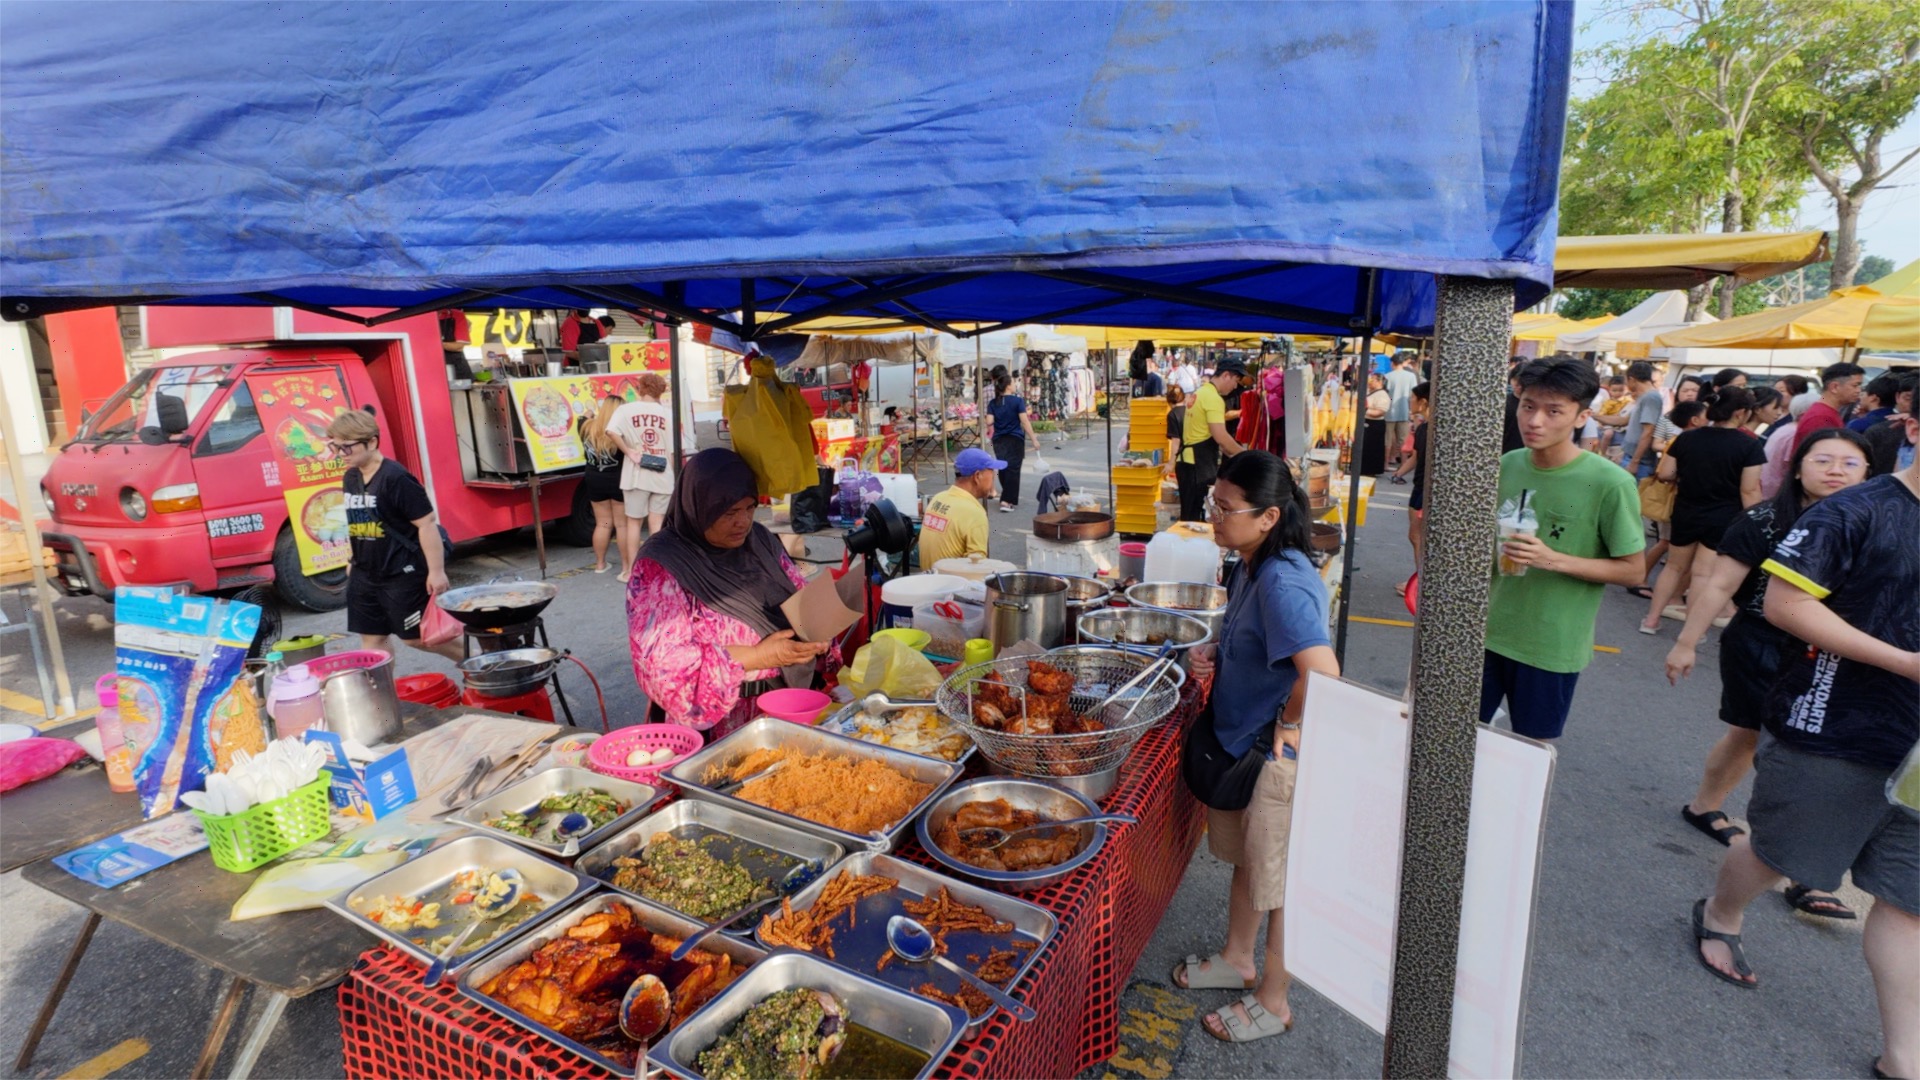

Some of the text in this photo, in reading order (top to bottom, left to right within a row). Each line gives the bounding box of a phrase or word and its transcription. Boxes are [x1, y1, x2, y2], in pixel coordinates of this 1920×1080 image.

[631, 414, 666, 431] HYPE
[1811, 650, 1829, 686] ICIAL
[1806, 653, 1842, 734] OENIXDARTS
